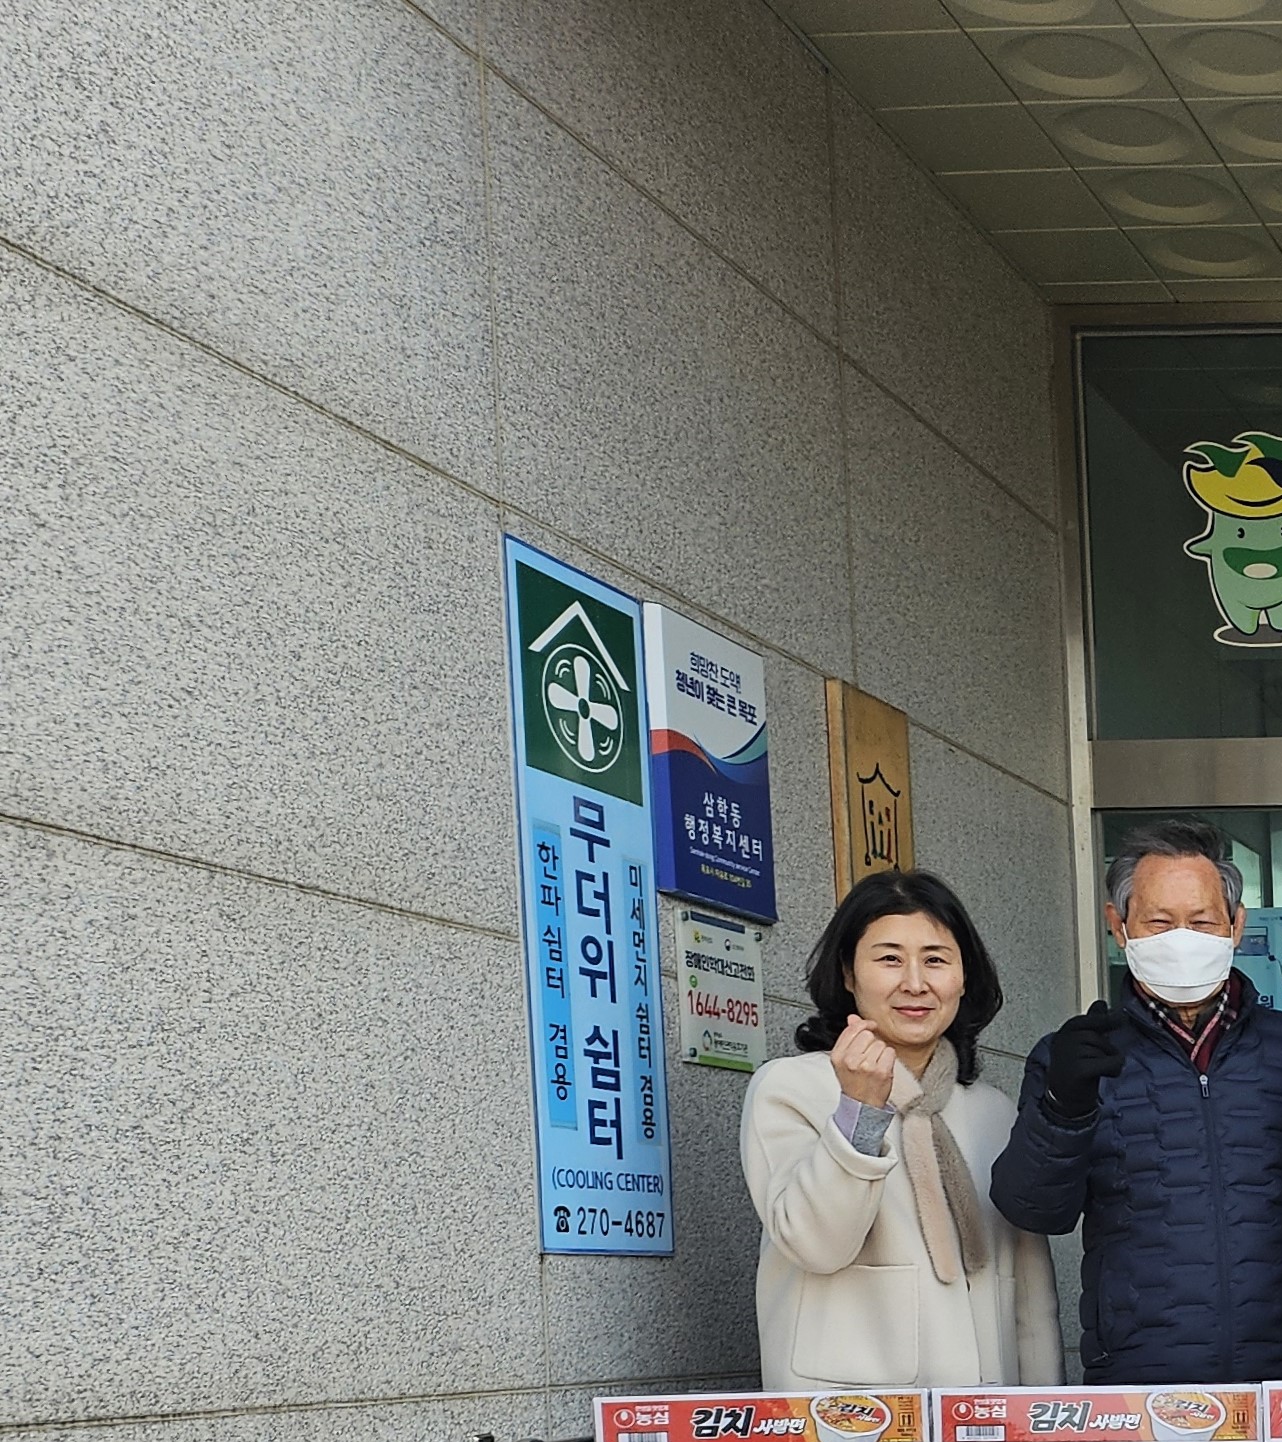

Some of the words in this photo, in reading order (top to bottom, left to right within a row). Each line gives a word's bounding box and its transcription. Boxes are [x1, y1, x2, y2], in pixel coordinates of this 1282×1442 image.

[690, 652, 719, 684] 희망찬
[675, 669, 705, 703] 청년이
[706, 685, 725, 712] 찾는
[727, 693, 737, 717] 큰
[738, 699, 758, 726] 목포
[703, 792, 742, 829] 삼학동
[684, 814, 763, 861] 행정복지센터
[536, 841, 560, 917] 한파
[569, 795, 618, 1004] 무더위
[628, 865, 648, 997] 미세먼지
[542, 926, 565, 999] 쉼터
[685, 950, 756, 982] 장애인학대신고전화
[688, 989, 759, 1027] 1644-8295
[635, 1003, 652, 1068] 쉼터
[549, 1023, 572, 1101] 겸용
[583, 1024, 624, 1160] 쉼터
[640, 1075, 655, 1140] 겸용
[552, 1166, 613, 1193] (COOLING
[616, 1169, 664, 1196] CENTER)
[577, 1208, 665, 1239] 270-4687
[636, 1412, 670, 1426] 농심
[690, 1406, 755, 1439] 김치
[752, 1418, 807, 1436] 사발면
[974, 1405, 1008, 1419] 농심
[1027, 1400, 1092, 1433] 김치
[1088, 1413, 1143, 1431] 사발면
